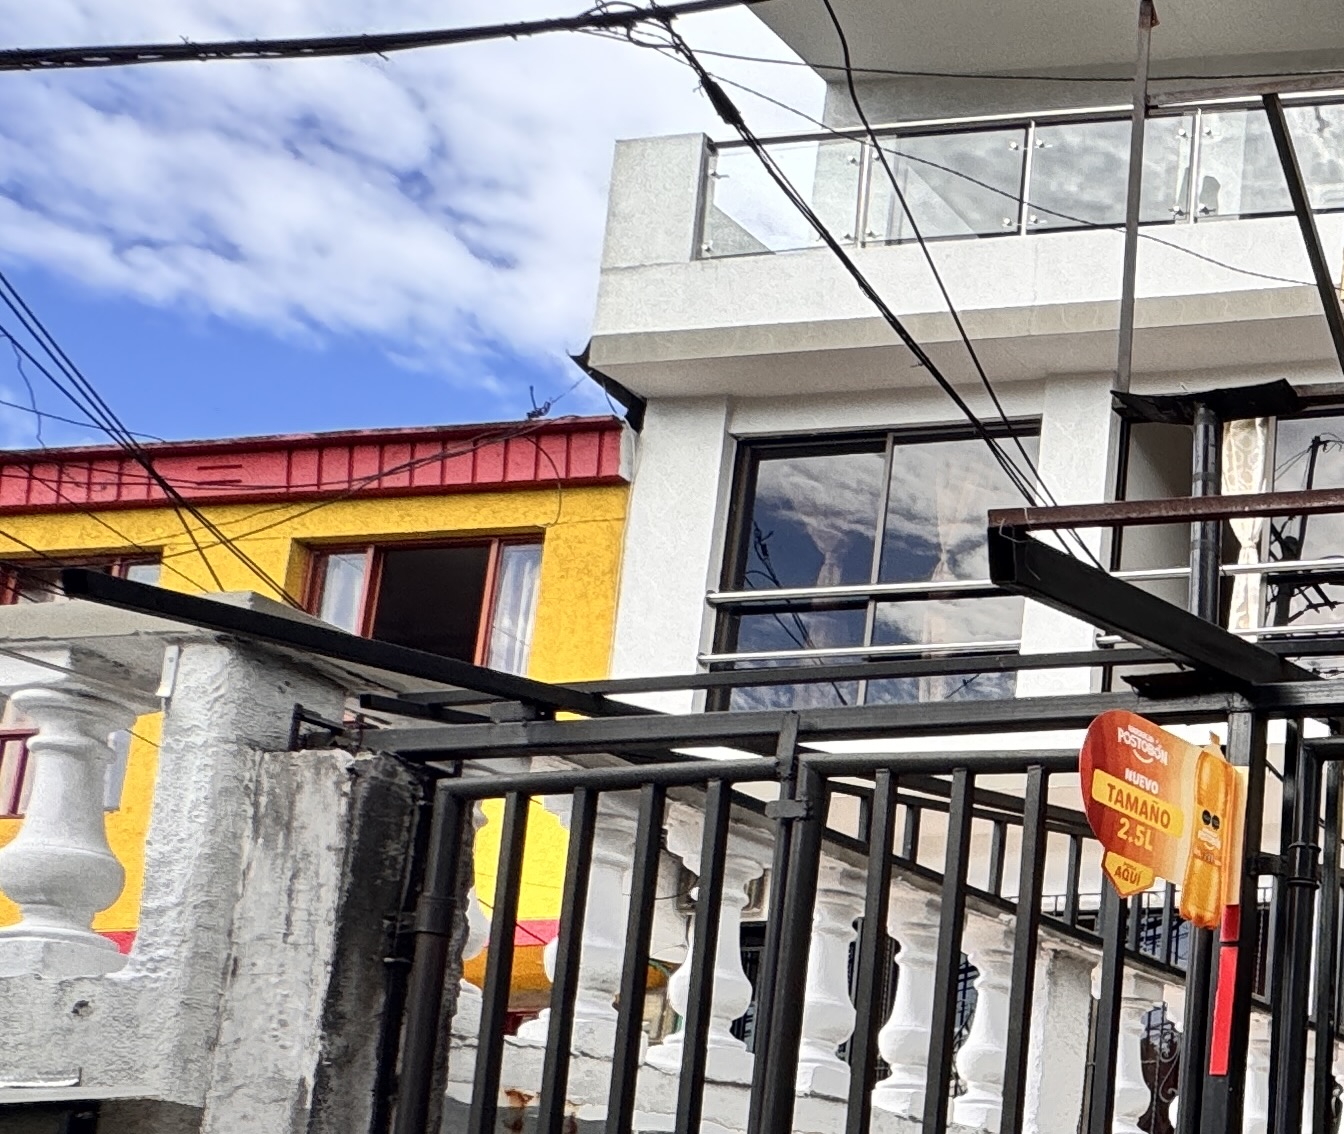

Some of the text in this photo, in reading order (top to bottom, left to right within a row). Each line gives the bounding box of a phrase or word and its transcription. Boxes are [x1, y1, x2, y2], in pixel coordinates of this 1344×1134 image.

[1125, 768, 1158, 794] NUEVO
[1107, 783, 1170, 829] TAMAÑO
[1117, 818, 1152, 851] 2.5L
